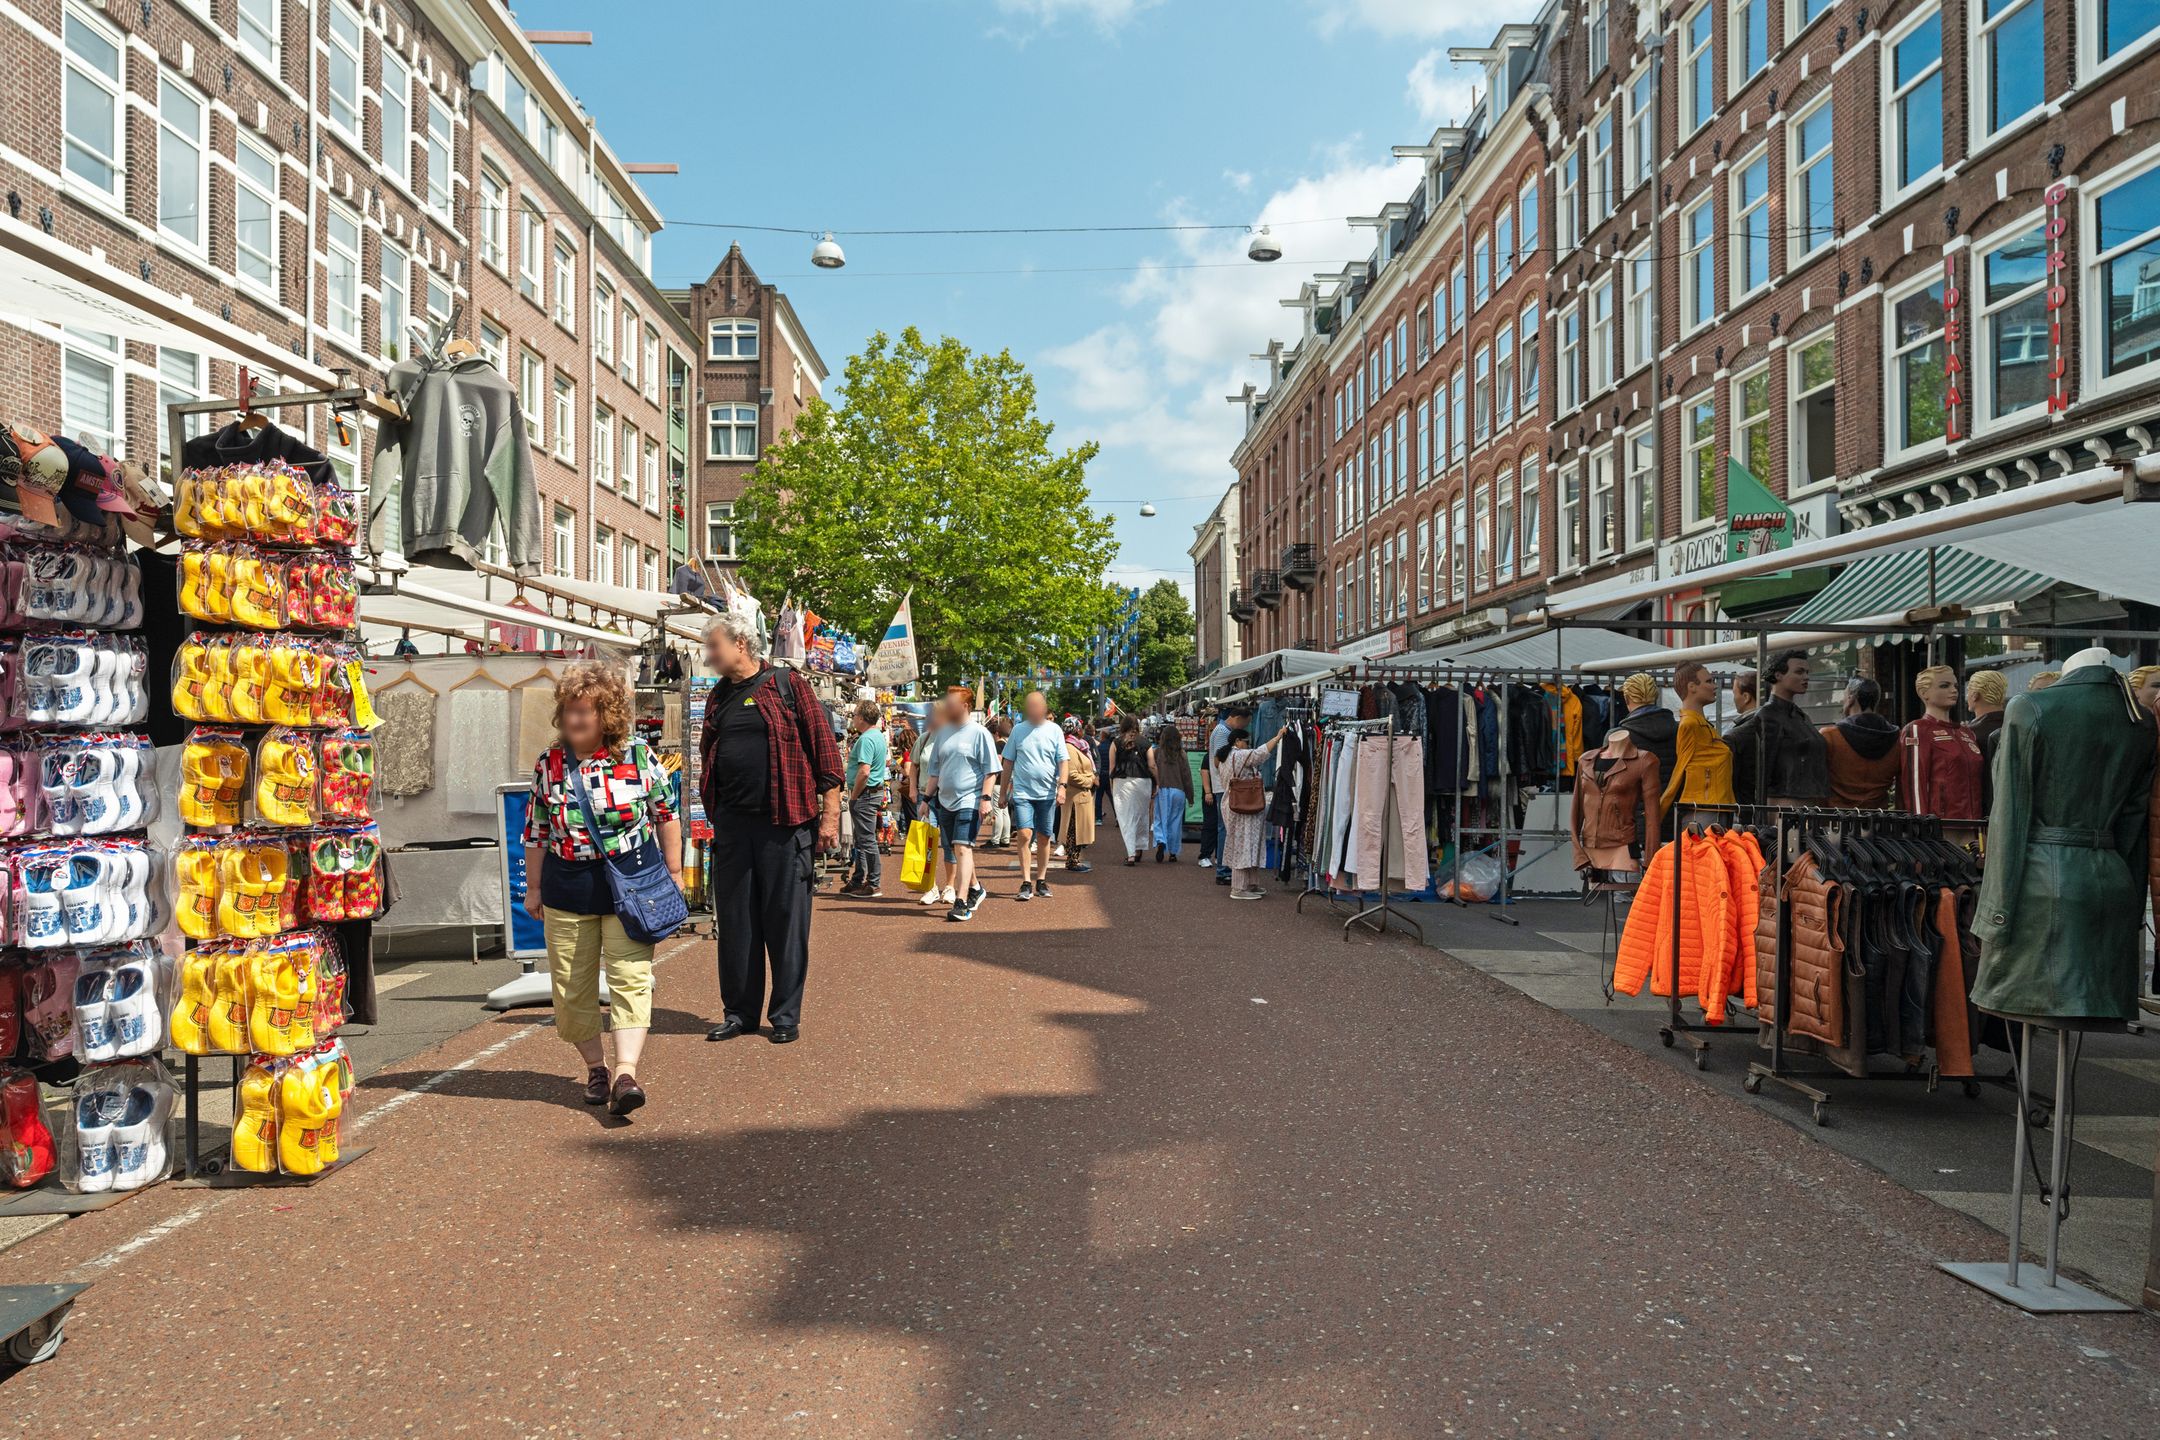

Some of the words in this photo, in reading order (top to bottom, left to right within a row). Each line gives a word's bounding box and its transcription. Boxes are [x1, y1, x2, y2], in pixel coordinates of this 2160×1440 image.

[2044, 182, 2069, 414] GORDIJN
[1943, 254, 1963, 444] IDEAAL
[1730, 511, 1787, 532] RANCHI
[1629, 570, 1645, 584] 262
[1722, 630, 1735, 642] 260
